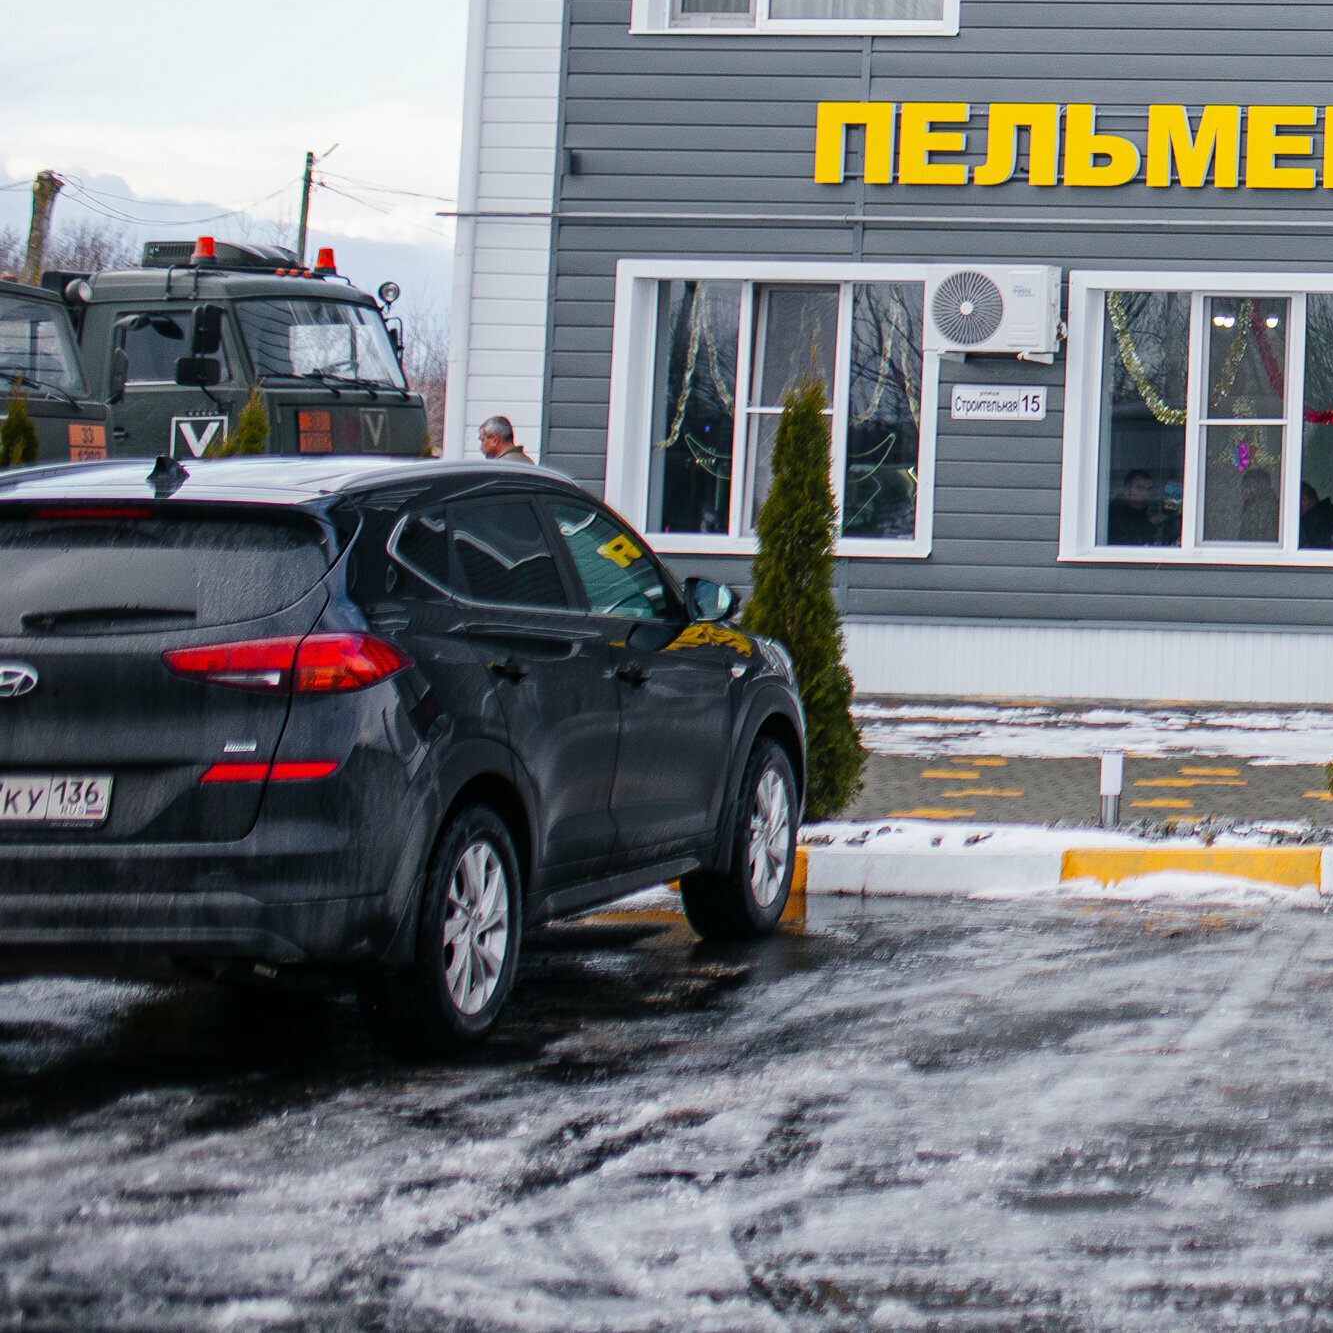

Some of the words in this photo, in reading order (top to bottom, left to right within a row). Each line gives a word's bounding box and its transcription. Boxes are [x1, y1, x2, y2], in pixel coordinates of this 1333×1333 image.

[955, 395, 1018, 416] Строительная
[1021, 394, 1041, 412] 15
[178, 421, 221, 458] V
[364, 413, 385, 447] V
[53, 780, 99, 805] 136
